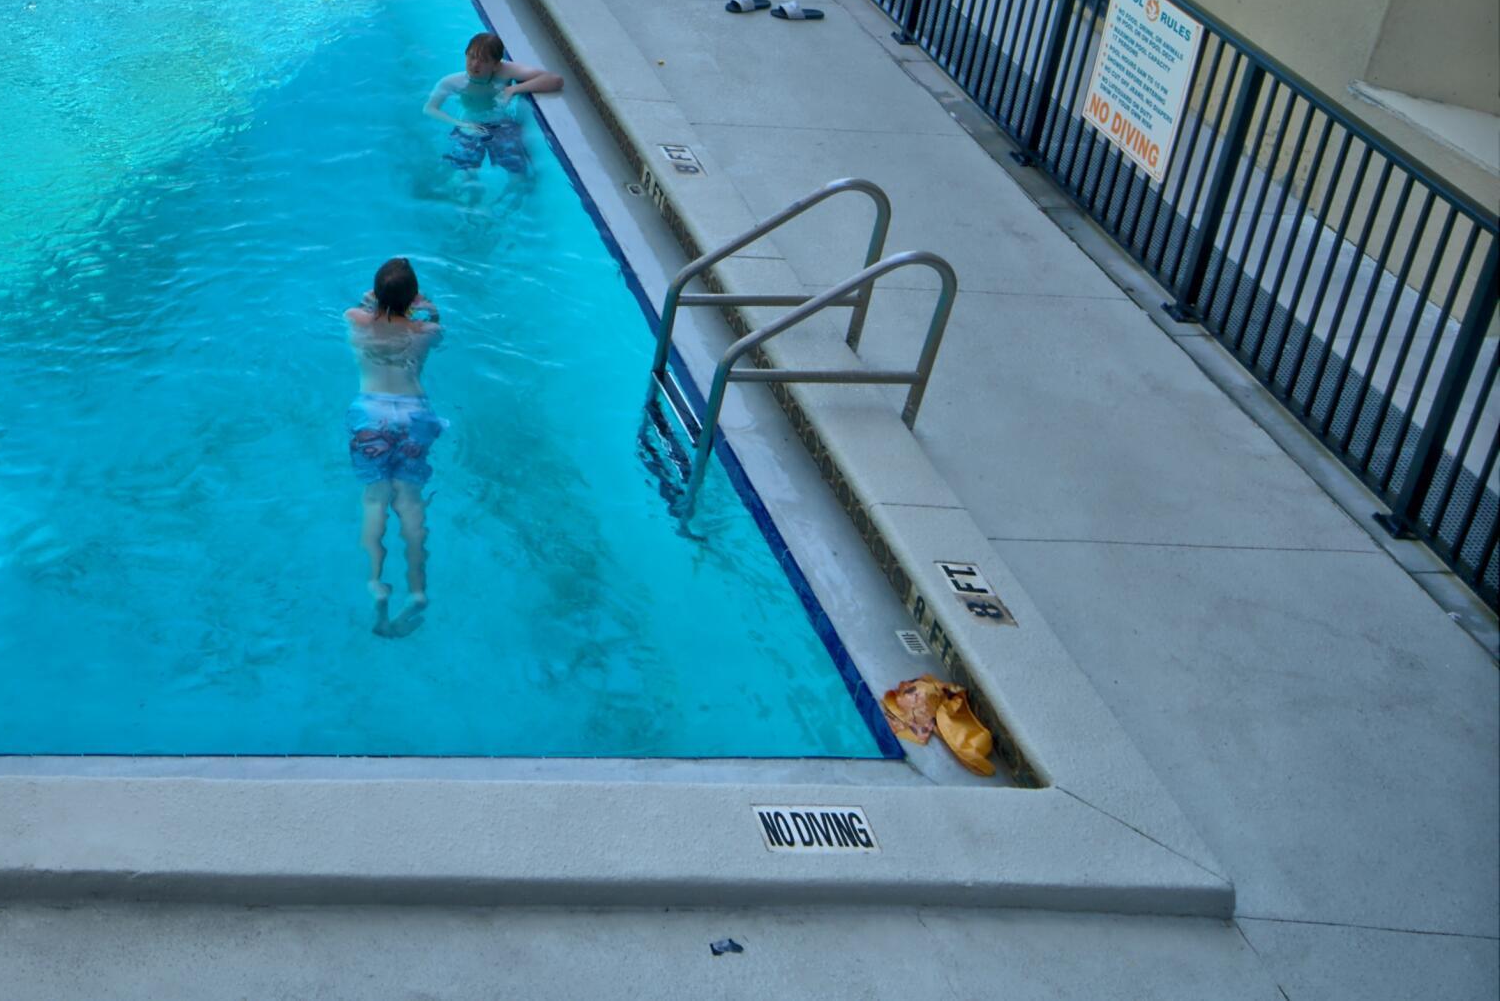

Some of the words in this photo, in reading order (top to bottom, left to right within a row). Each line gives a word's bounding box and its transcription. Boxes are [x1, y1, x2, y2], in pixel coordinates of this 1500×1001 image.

[1160, 12, 1192, 42] RULES
[1110, 45, 1120, 57] POOL
[1121, 54, 1136, 70] HOURS
[1114, 26, 1135, 46] MAXIMUM
[1135, 42, 1147, 55] POOL
[1148, 52, 1170, 73] CAPACITY
[1118, 38, 1138, 57] PERSONS
[1149, 40, 1161, 53] POOL
[1162, 50, 1175, 63] DECK
[1105, 65, 1111, 74] NO
[1153, 104, 1173, 124] DIAPERS
[1107, 55, 1124, 72] SHOWER
[1126, 70, 1142, 86] BEFORE
[1143, 83, 1165, 105] ENTERING
[1100, 83, 1111, 96] SWIM
[1118, 98, 1130, 111] YOUR
[1142, 117, 1152, 130] RISK
[1102, 76, 1108, 84] NO
[1109, 81, 1132, 104] LIFEGUARD
[1140, 107, 1152, 120] DUTY
[1089, 93, 1109, 124] NO
[1111, 112, 1160, 167] DIVING
[675, 163, 699, 174] 8
[913, 595, 925, 624] 8
[966, 601, 1004, 619] 8
[758, 811, 795, 847] NO
[789, 811, 874, 848] DIVING
